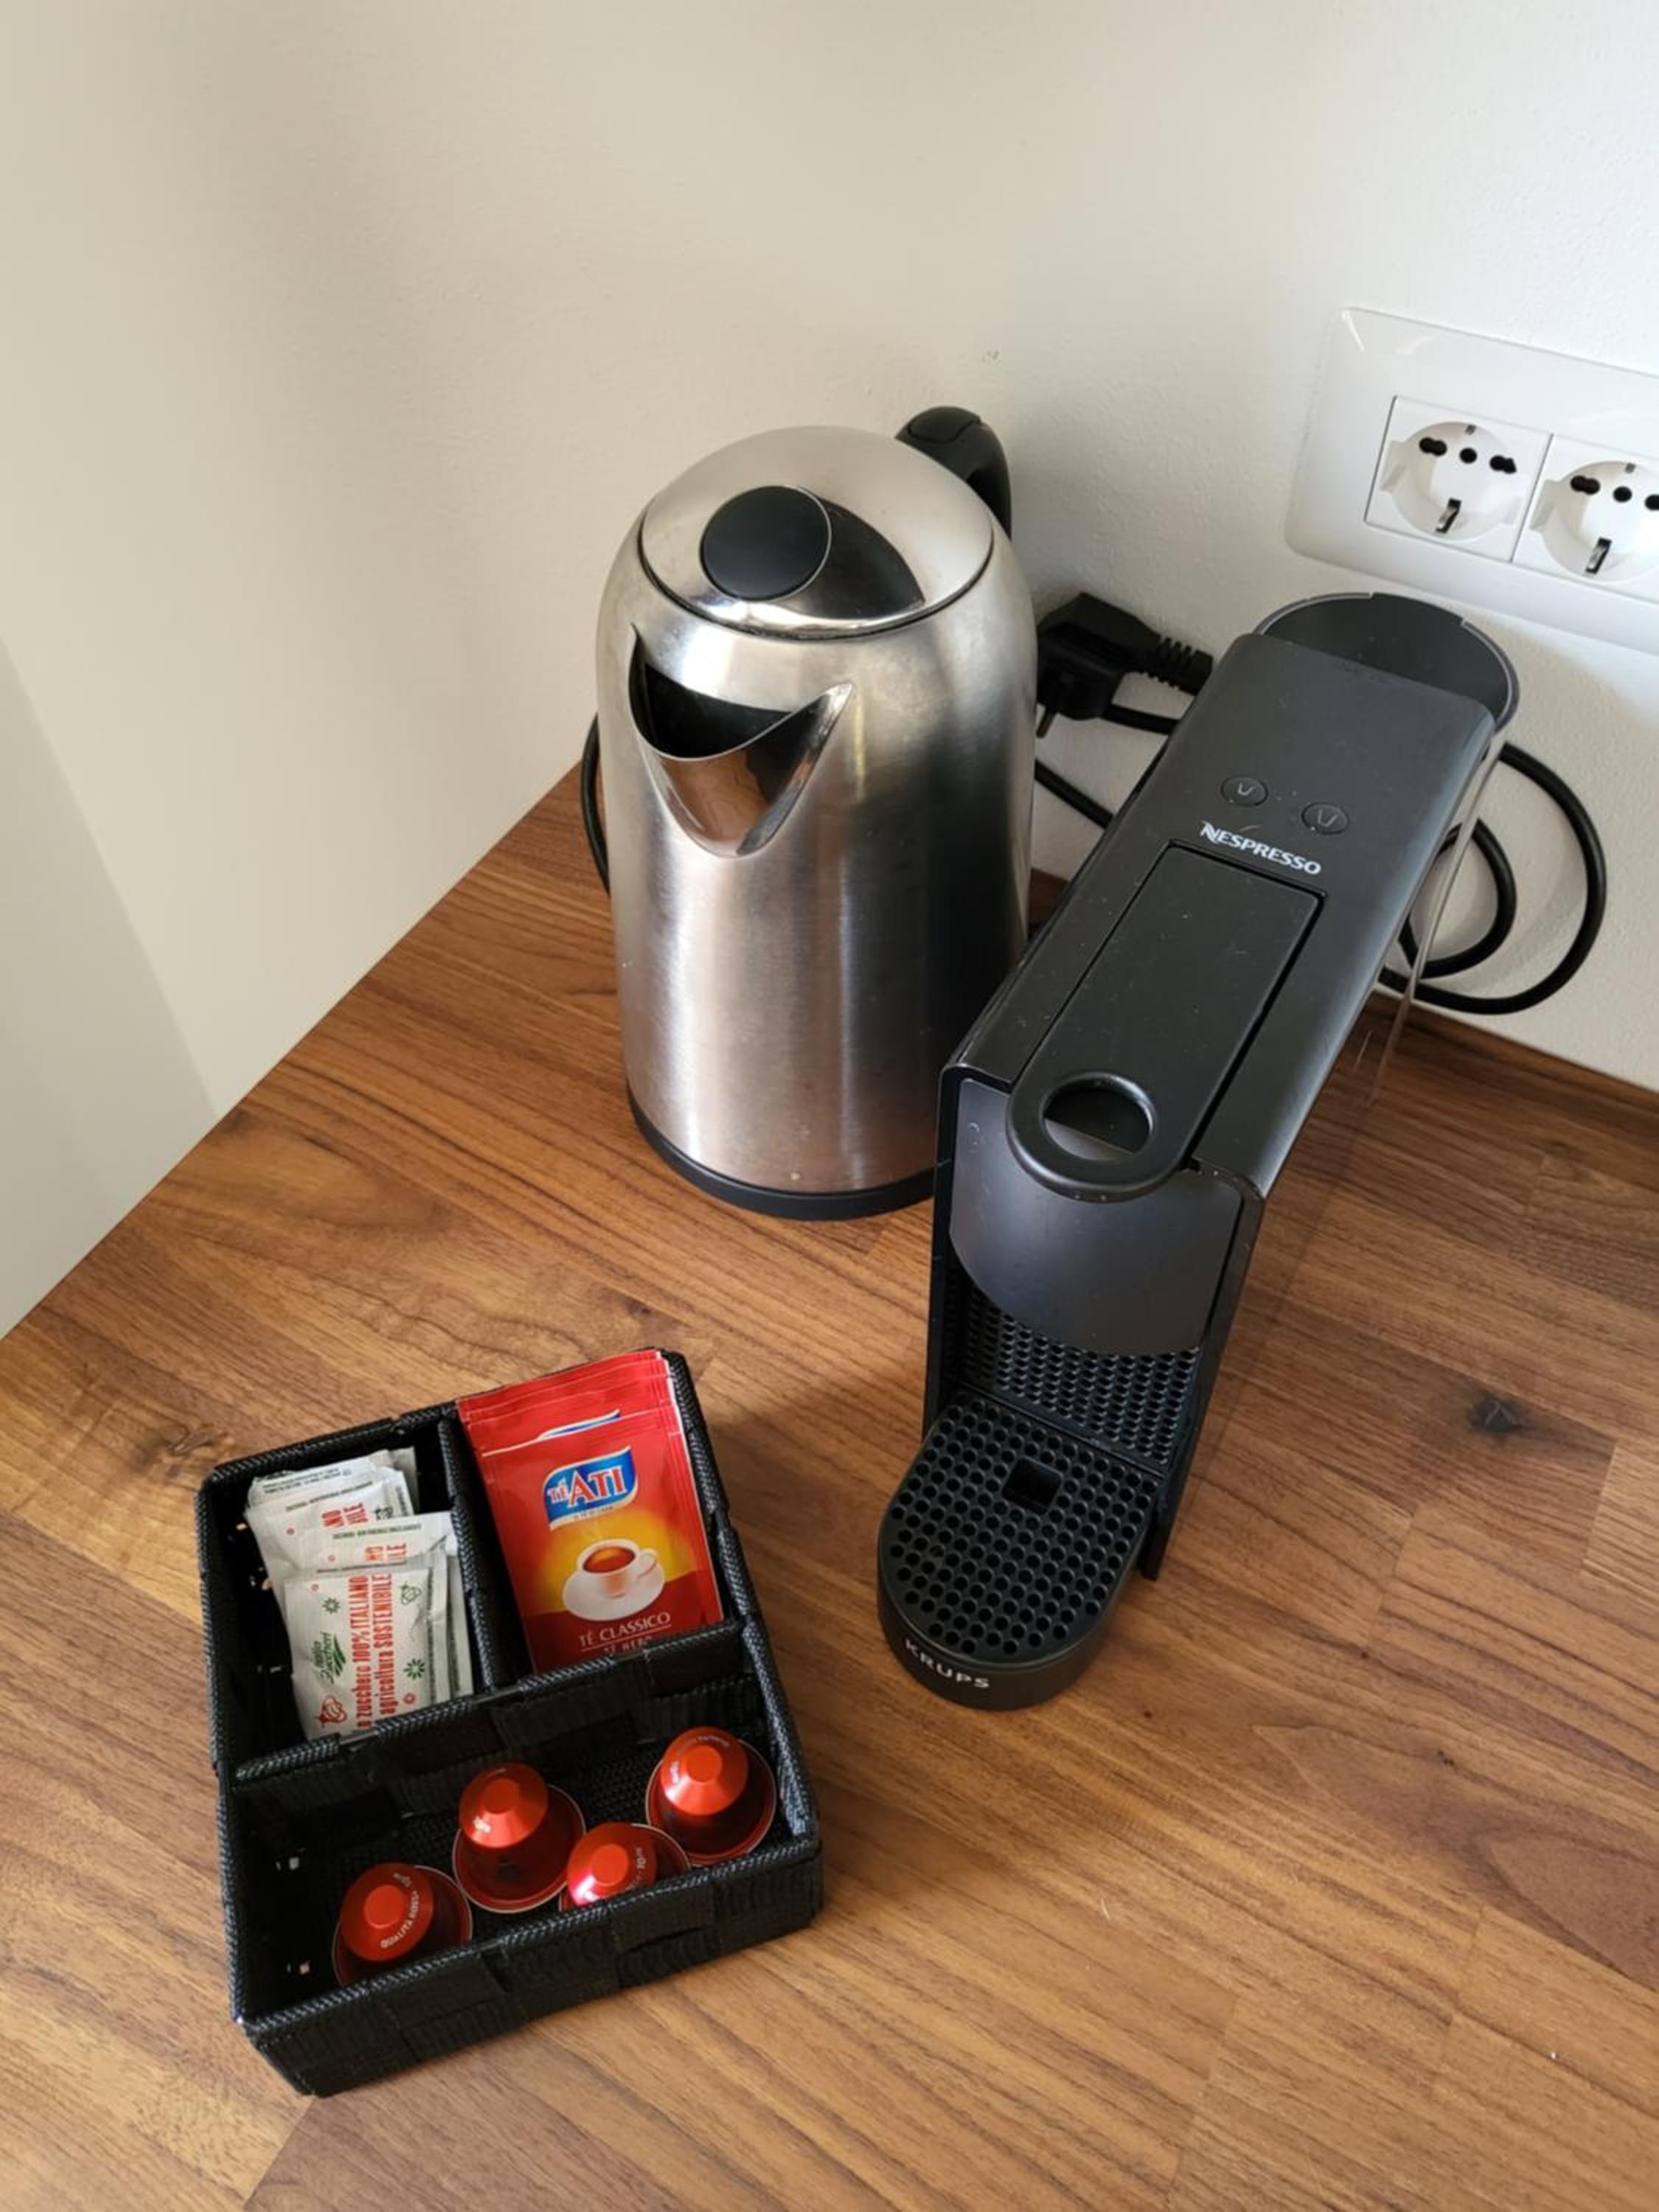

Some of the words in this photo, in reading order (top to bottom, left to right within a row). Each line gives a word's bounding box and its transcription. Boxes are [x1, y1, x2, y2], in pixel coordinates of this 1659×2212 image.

[1200, 822, 1322, 875] NESPRESSO
[567, 1464, 627, 1509] ATI
[348, 1576, 369, 1629] ITALIANO
[372, 1573, 395, 1649] SOSTENIBILE
[599, 1611, 672, 1641] CLASSICO
[351, 1631, 370, 1662] 100%
[905, 1638, 990, 1689] KRUPS
[350, 1666, 372, 1719] zucchero
[374, 1651, 398, 1715] agricoltura
